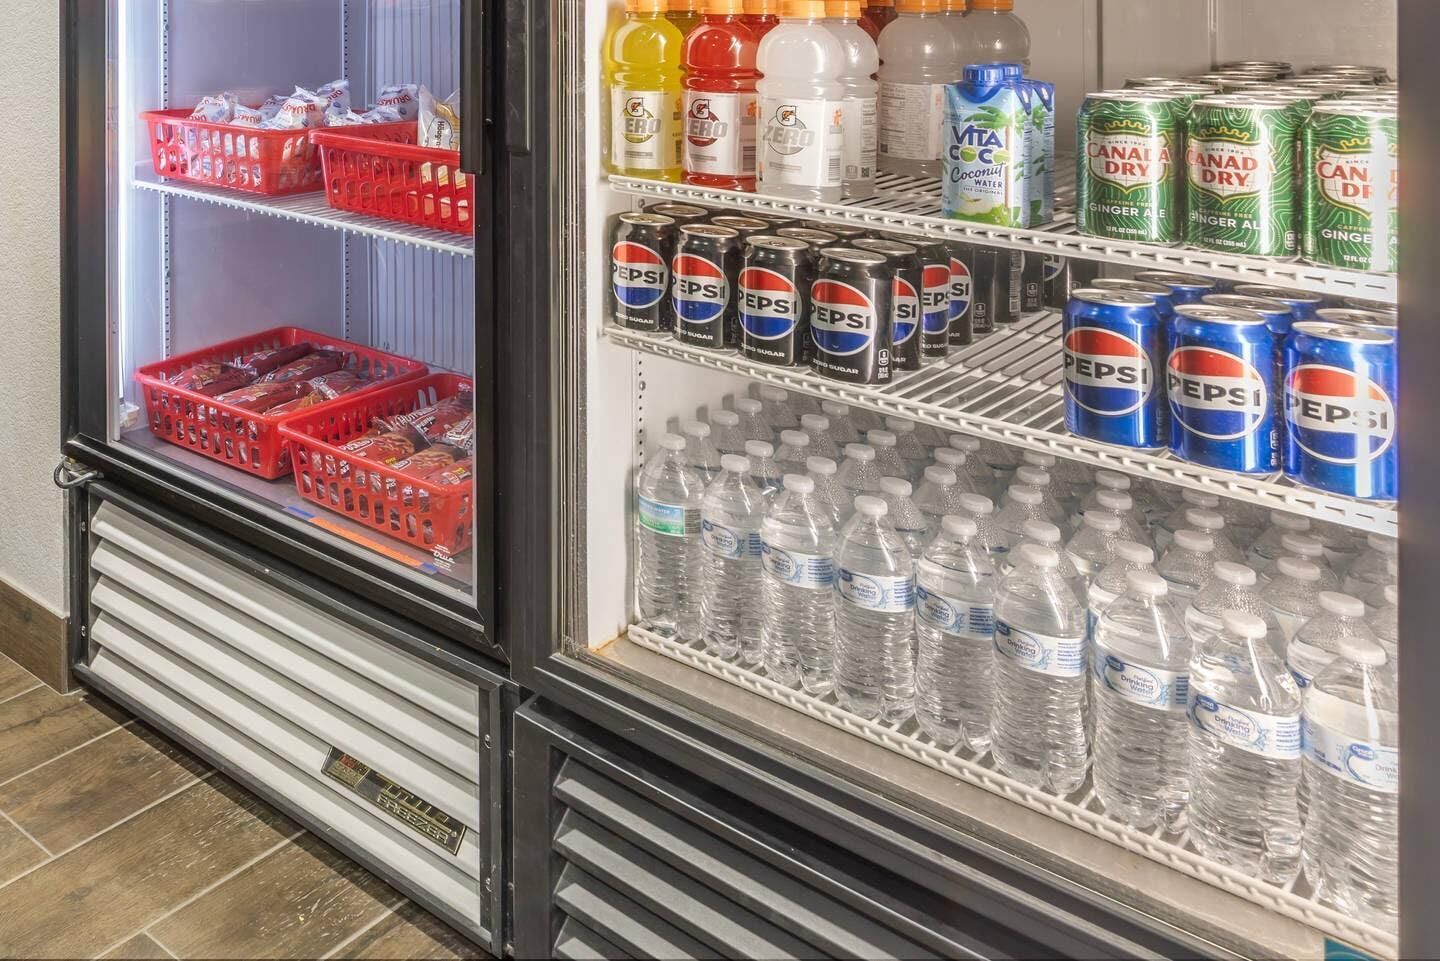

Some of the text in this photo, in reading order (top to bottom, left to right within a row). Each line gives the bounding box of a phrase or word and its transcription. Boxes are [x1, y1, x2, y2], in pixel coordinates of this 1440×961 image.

[762, 125, 815, 146] ZERO
[952, 125, 1003, 148] VITA
[949, 145, 1010, 164] COCO
[1187, 149, 1276, 173] CANAD
[951, 163, 1005, 183] Coconut
[1105, 161, 1149, 176] DRY
[1202, 169, 1250, 187] DRY
[975, 179, 1003, 188] WATER
[1089, 203, 1166, 218] GINGER AE
[1189, 211, 1261, 230] GINGER AL
[1322, 229, 1372, 244] GINGE
[613, 264, 664, 285] PEPSI
[672, 277, 725, 299] PEPSI
[738, 291, 797, 314] PEPSI
[629, 316, 654, 324] SUGAR
[811, 306, 871, 329] PEPSI
[687, 331, 713, 340] SUGAR
[757, 348, 785, 358] SUGAR
[829, 365, 859, 374] SUGAR
[1065, 354, 1147, 385] PEPSI
[1169, 374, 1261, 408] PEPSI
[1286, 393, 1388, 431] PEPSI
[1008, 639, 1036, 654] Drinking
[1121, 674, 1154, 690] Drinking
[1214, 715, 1250, 734] Drinking
[377, 794, 449, 844] FREEZER
